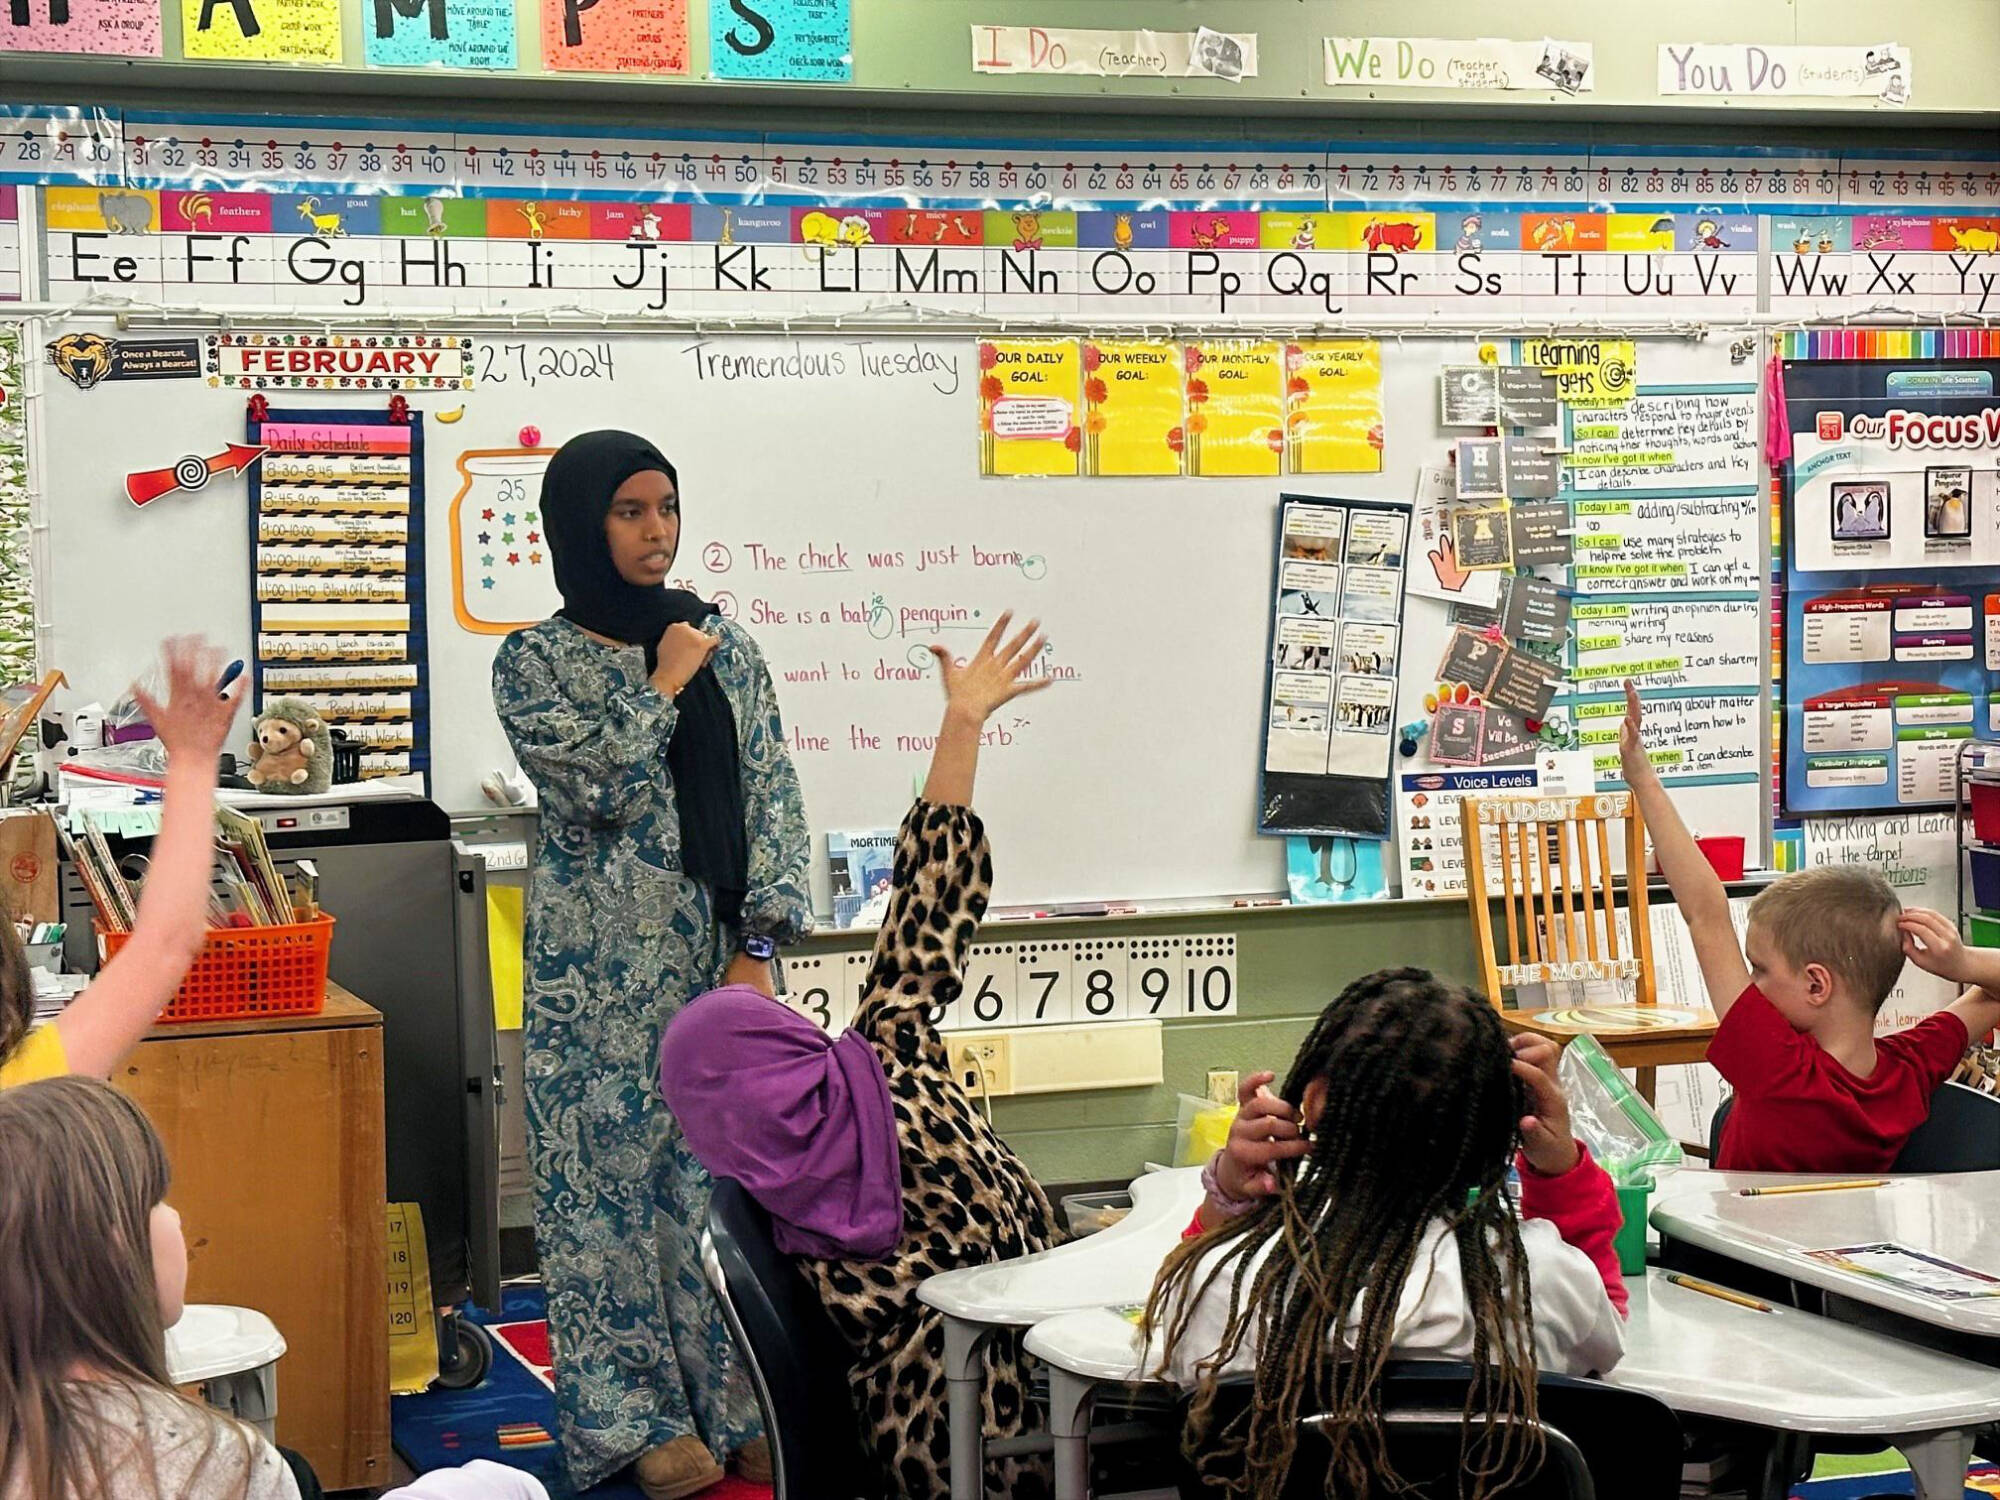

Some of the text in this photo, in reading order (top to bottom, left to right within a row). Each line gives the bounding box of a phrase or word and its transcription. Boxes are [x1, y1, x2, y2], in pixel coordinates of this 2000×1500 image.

[978, 28, 1012, 67] I
[1030, 28, 1067, 69] Do
[1329, 38, 1382, 81] We
[1399, 43, 1435, 80] Do
[1670, 47, 1732, 91] You
[1746, 48, 1786, 89] Do
[132, 147, 1664, 193] 31 32 33 34 35 36 37 51 52 53 54 71 72 73 74 81 82 83
[346, 198, 368, 209] goat
[400, 206, 417, 217] hat
[864, 209, 882, 219] lion
[1140, 220, 1157, 230] owl
[71, 231, 1916, 315] Ee Ff Gg Hh Jj Kk Mm Nn Oo Pp Qq Rr Ss Vv Ww Xx
[121, 349, 187, 360] Once a Bearcat,
[121, 358, 197, 371] Always a Bearcat!
[241, 350, 442, 374] FEBRUARY
[996, 351, 1064, 365] OUR DAILY
[1097, 353, 1168, 365] OUR WEEKLY
[1221, 353, 1270, 365] MONTHLY
[1328, 351, 1364, 364] YEARLY
[680, 341, 959, 395] Tremendous Tuesday
[1011, 370, 1049, 383] GOAL:
[1116, 370, 1149, 382] GOAL:
[1218, 369, 1249, 380] GOAL:
[1559, 369, 1595, 394] gets
[1630, 397, 1729, 418] describing how
[1853, 418, 1885, 435] Our
[267, 428, 370, 451] Daily Schedule
[1807, 451, 1852, 474] ANCHOR TEXT
[497, 478, 527, 503] 25
[1577, 502, 1606, 514] Today
[1615, 503, 1631, 511] am
[1577, 537, 1590, 548] So
[1599, 537, 1618, 547] can
[744, 543, 787, 571] The
[799, 542, 849, 570] chick
[867, 551, 904, 568] was
[916, 546, 960, 572] just
[750, 598, 788, 626] She
[797, 606, 813, 625] is
[819, 609, 831, 625] a
[900, 607, 968, 639] penguin
[1624, 632, 1714, 648] share my reasons
[784, 660, 830, 683] want
[841, 662, 861, 681] to
[1685, 696, 1755, 711] about matter
[848, 724, 881, 750] the
[1453, 775, 1489, 790] Voice
[1491, 773, 1532, 788] Levels
[1477, 796, 1629, 825] STUDENT OF
[850, 836, 899, 849] MORTIME
[1808, 815, 1910, 852] Working and
[487, 848, 512, 867] 2nd
[1815, 847, 1833, 865] at
[1840, 845, 1860, 862] the
[1497, 963, 1542, 986] THE
[973, 965, 1232, 1023] 6 7 8 9 10
[389, 1311, 413, 1326] 120
